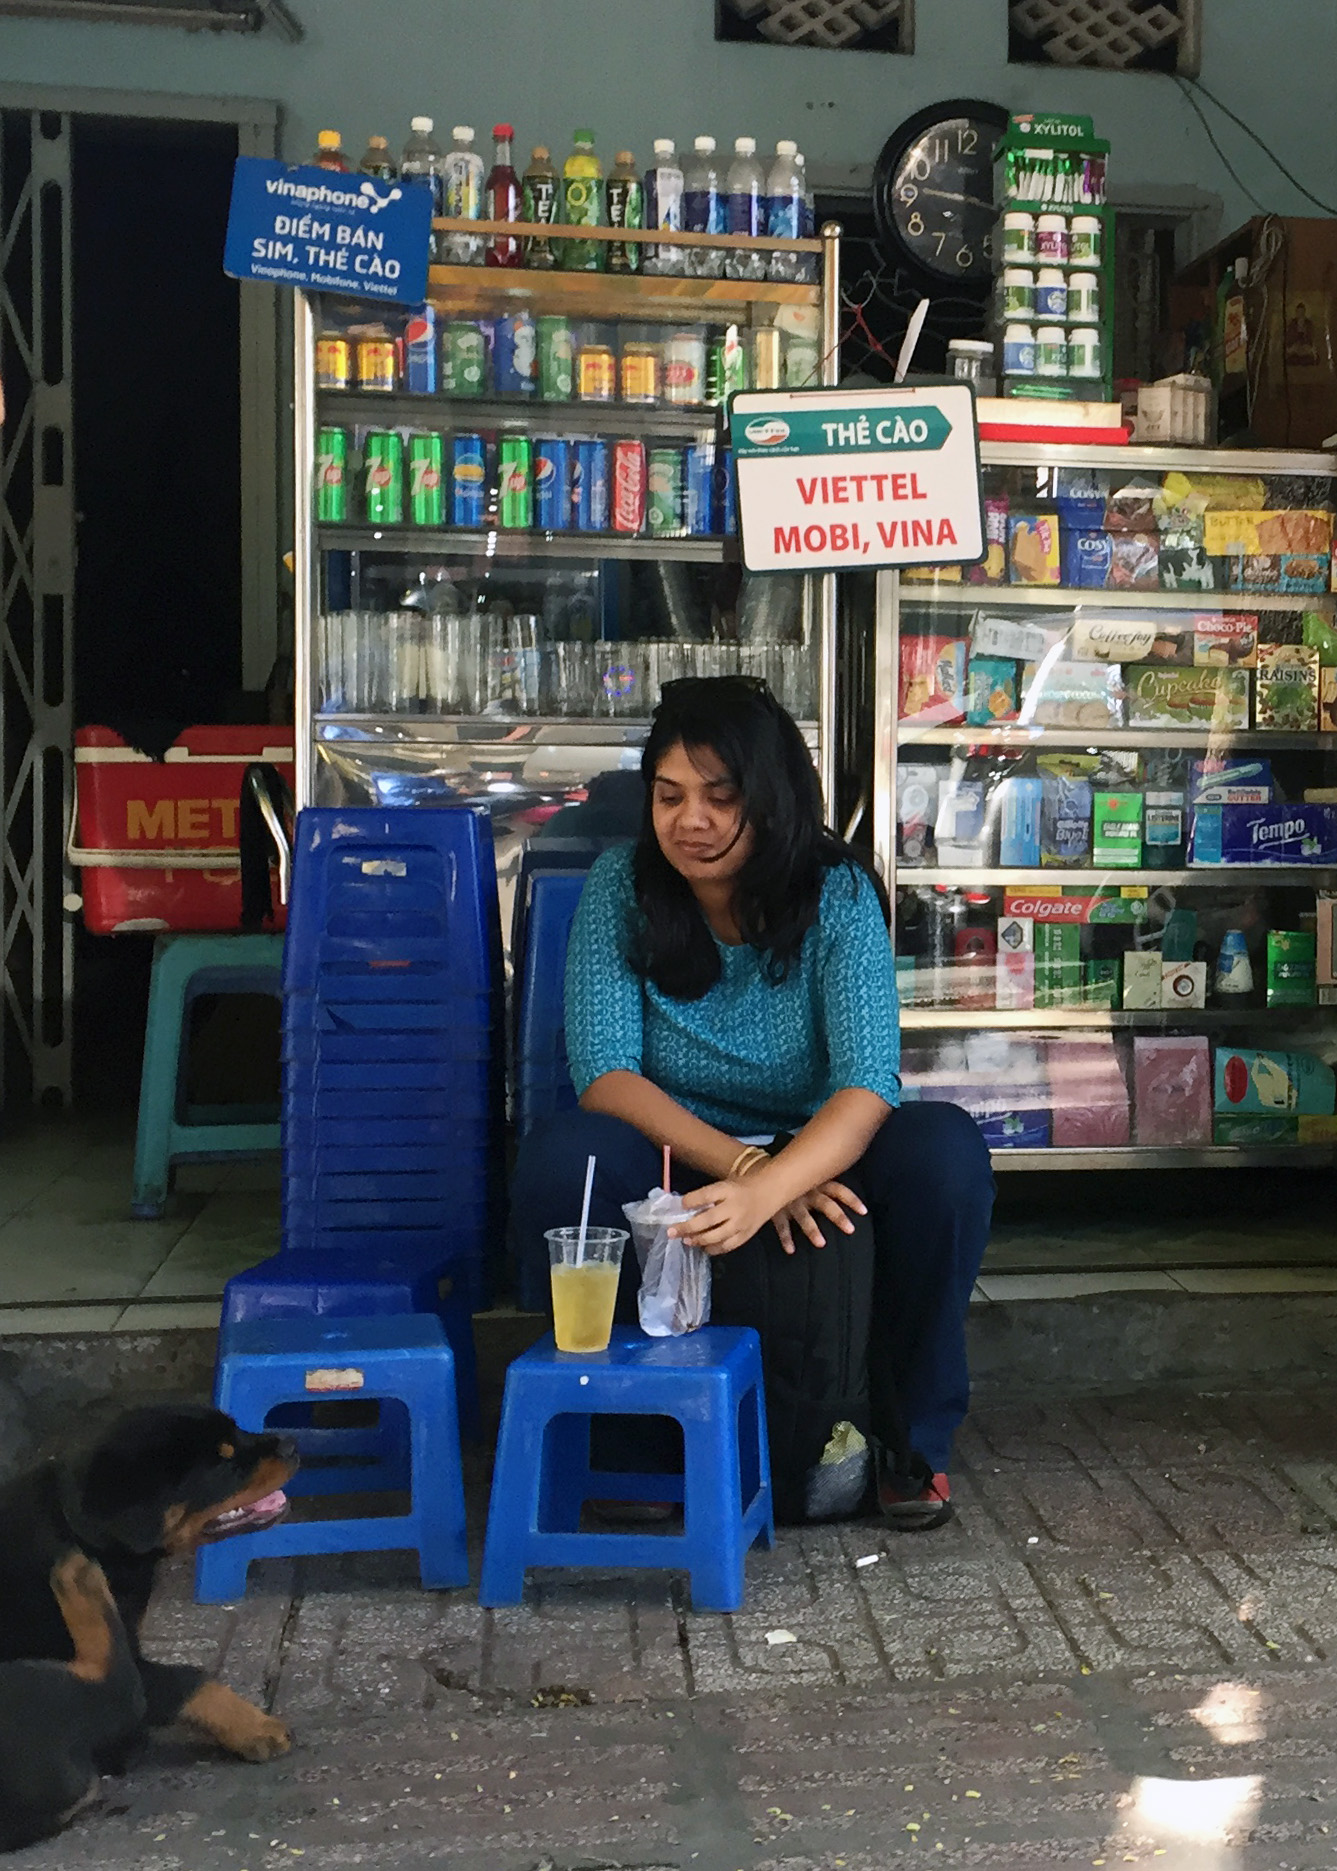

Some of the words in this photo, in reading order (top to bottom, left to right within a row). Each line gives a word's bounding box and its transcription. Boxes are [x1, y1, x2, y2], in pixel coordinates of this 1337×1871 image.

[958, 129, 978, 155] 12
[1034, 123, 1084, 137] XYLITOL
[935, 139, 948, 163] 11
[265, 178, 370, 209] vinaphone
[900, 183, 918, 208] 9
[908, 211, 924, 236] 8
[337, 225, 384, 251] BÁN
[931, 232, 946, 257] 7
[252, 238, 299, 264] SIM,
[355, 252, 400, 279] CÀO
[956, 244, 973, 267] 6
[822, 414, 871, 447] THẺ
[876, 414, 928, 444] CÀO
[796, 472, 927, 505] VIETTEL
[774, 523, 870, 554] MOBI,
[877, 518, 957, 548] VINA
[1259, 668, 1317, 683] RAISINS
[1247, 818, 1305, 844] Tempo
[1010, 900, 1083, 915] Colgate
